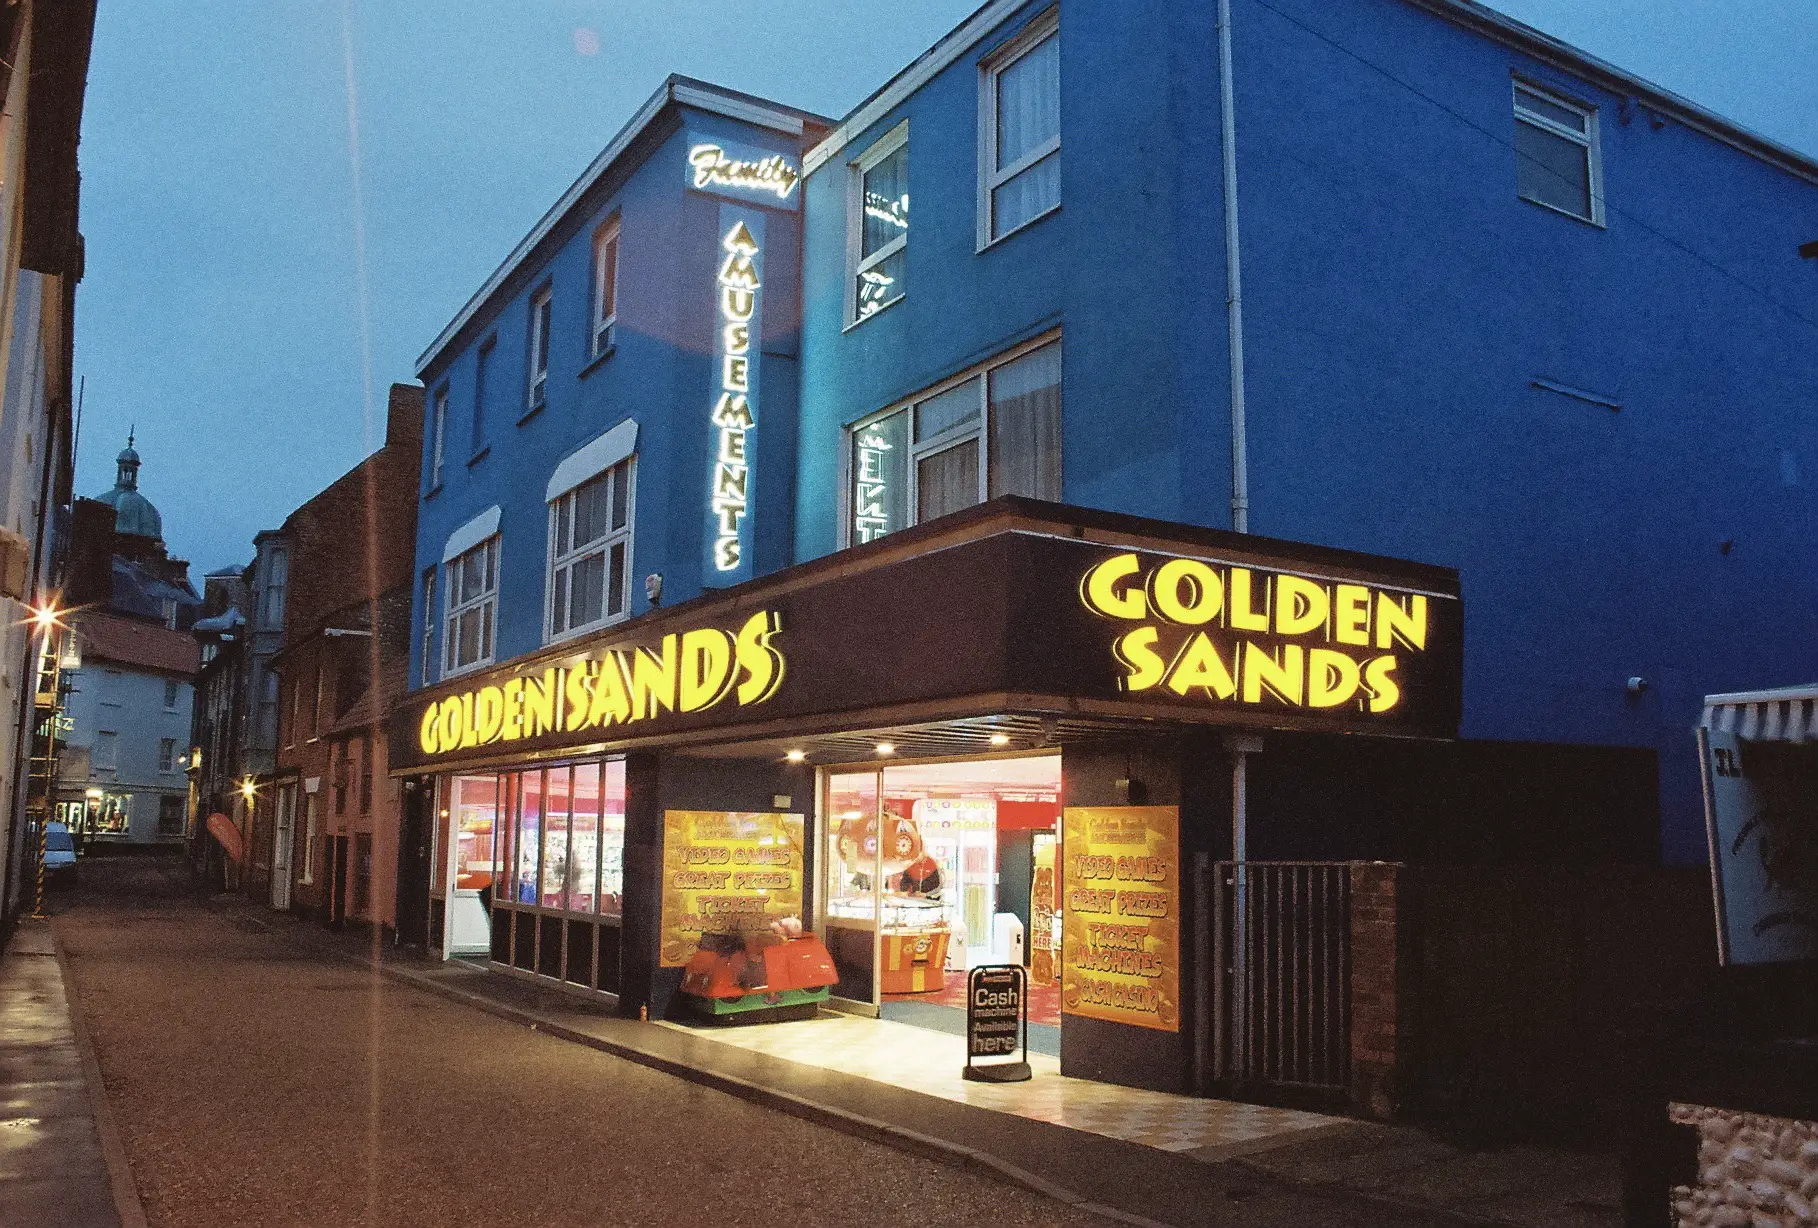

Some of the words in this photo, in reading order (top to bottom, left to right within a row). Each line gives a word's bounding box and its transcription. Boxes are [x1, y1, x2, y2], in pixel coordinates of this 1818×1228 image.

[689, 144, 798, 199] Family
[712, 221, 761, 571] AMUSEMENTS
[1080, 553, 1427, 651] GOLDEN
[419, 668, 564, 754] GOLDEN
[566, 610, 785, 731] SANDS
[1113, 626, 1400, 713] SANDS
[676, 846, 731, 865] VIDEO
[733, 846, 791, 866] GAMES
[1075, 855, 1115, 880] VIDEO
[1116, 856, 1167, 882] GAMES
[674, 871, 731, 889] GREAT
[733, 871, 791, 889] PRIZES
[696, 896, 770, 914] TICKET
[1070, 888, 1116, 915] GREAT
[1117, 890, 1168, 918] PRIZES
[1088, 922, 1149, 951] TICKET
[1076, 945, 1163, 979] MACHINES
[975, 987, 1018, 1006] Cash
[1081, 978, 1112, 1007] CASH
[1113, 982, 1159, 1013] CASINO
[974, 1006, 1018, 1018] machine
[972, 1033, 1016, 1054] here
